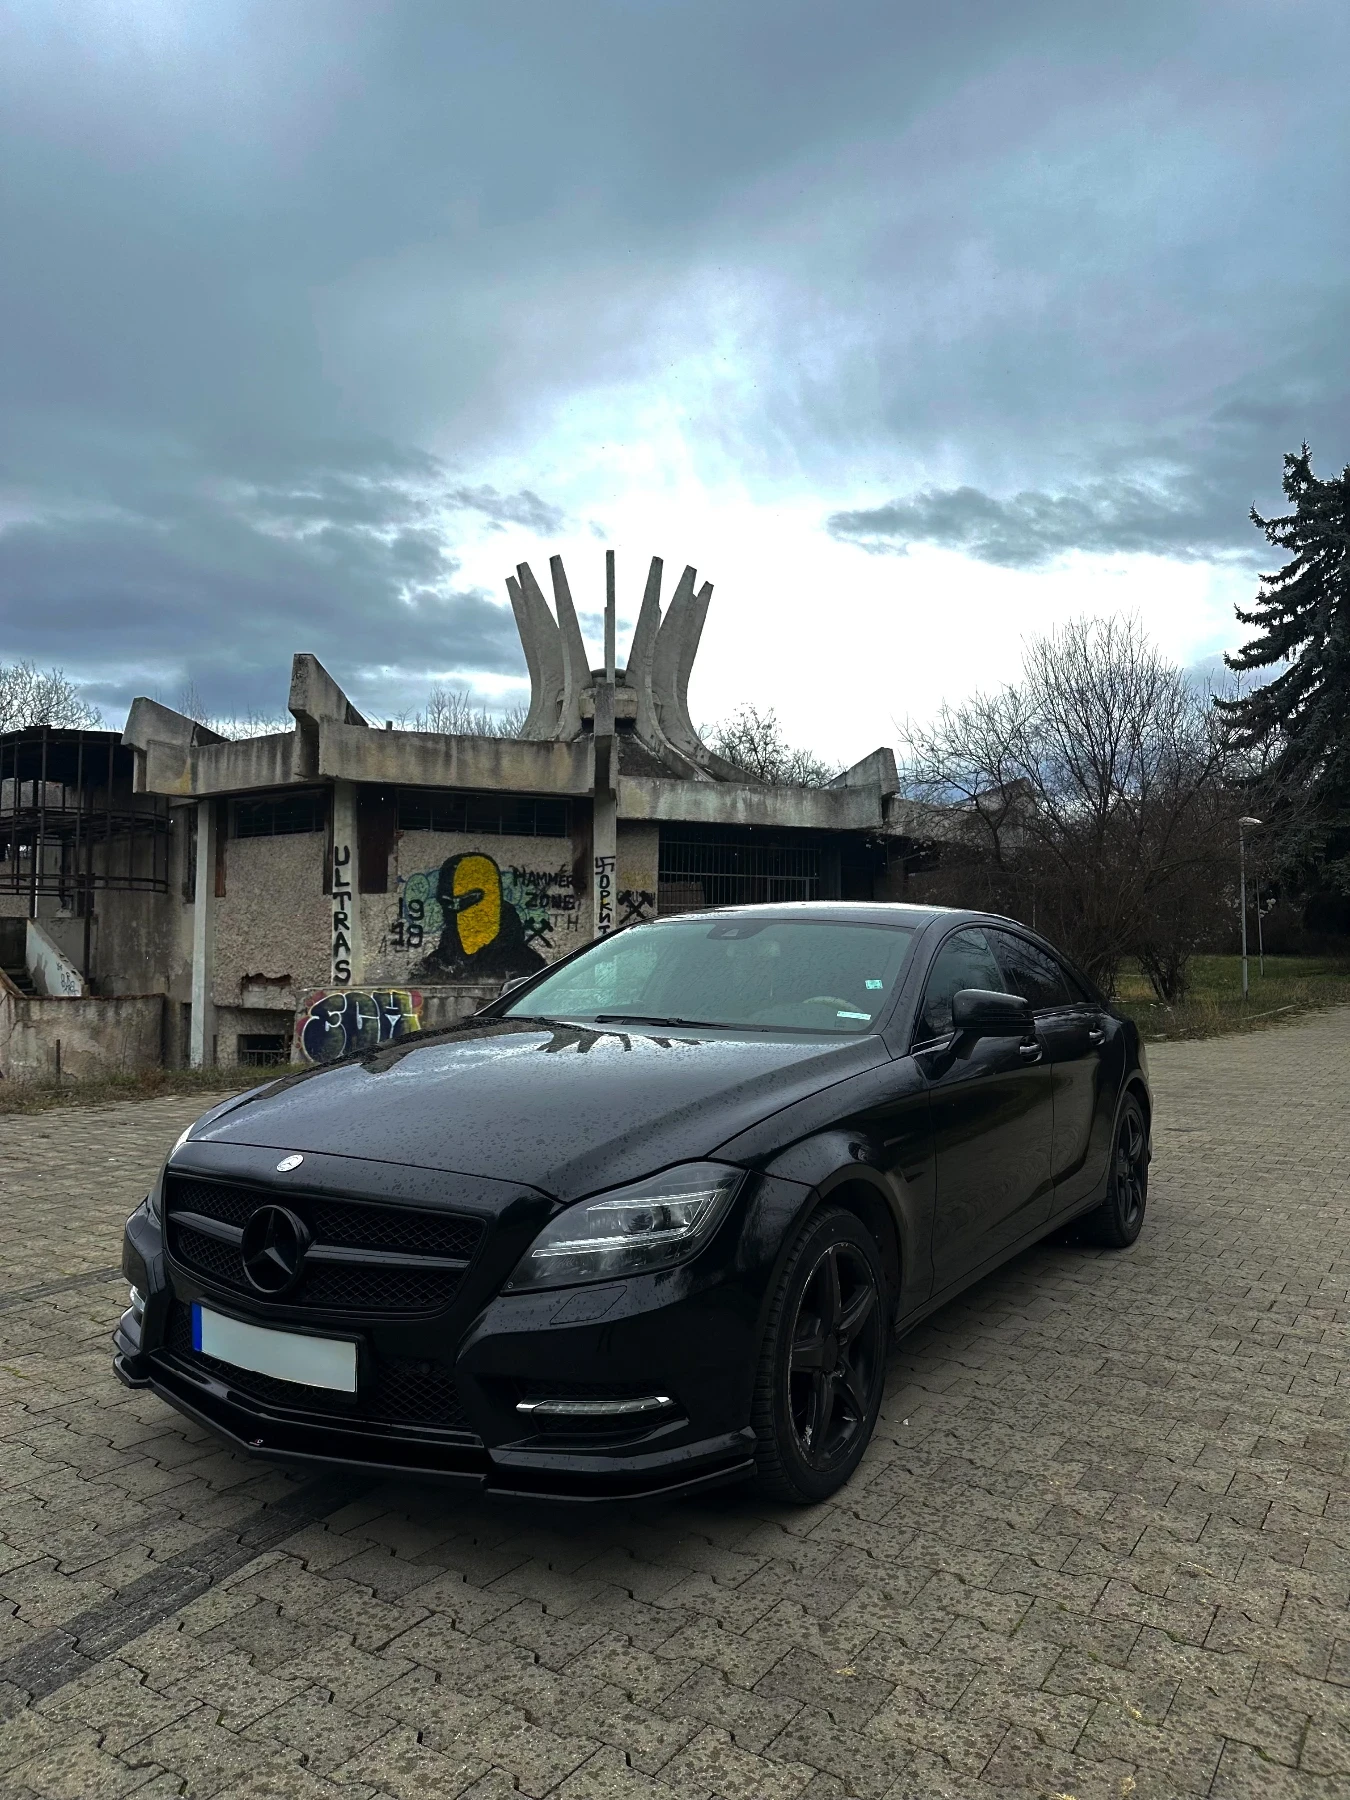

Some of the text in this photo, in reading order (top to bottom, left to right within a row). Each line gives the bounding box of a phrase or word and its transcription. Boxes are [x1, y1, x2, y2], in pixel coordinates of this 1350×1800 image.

[398, 897, 425, 920] 19
[525, 892, 576, 911] ZONE
[332, 845, 351, 984] ULTRAS
